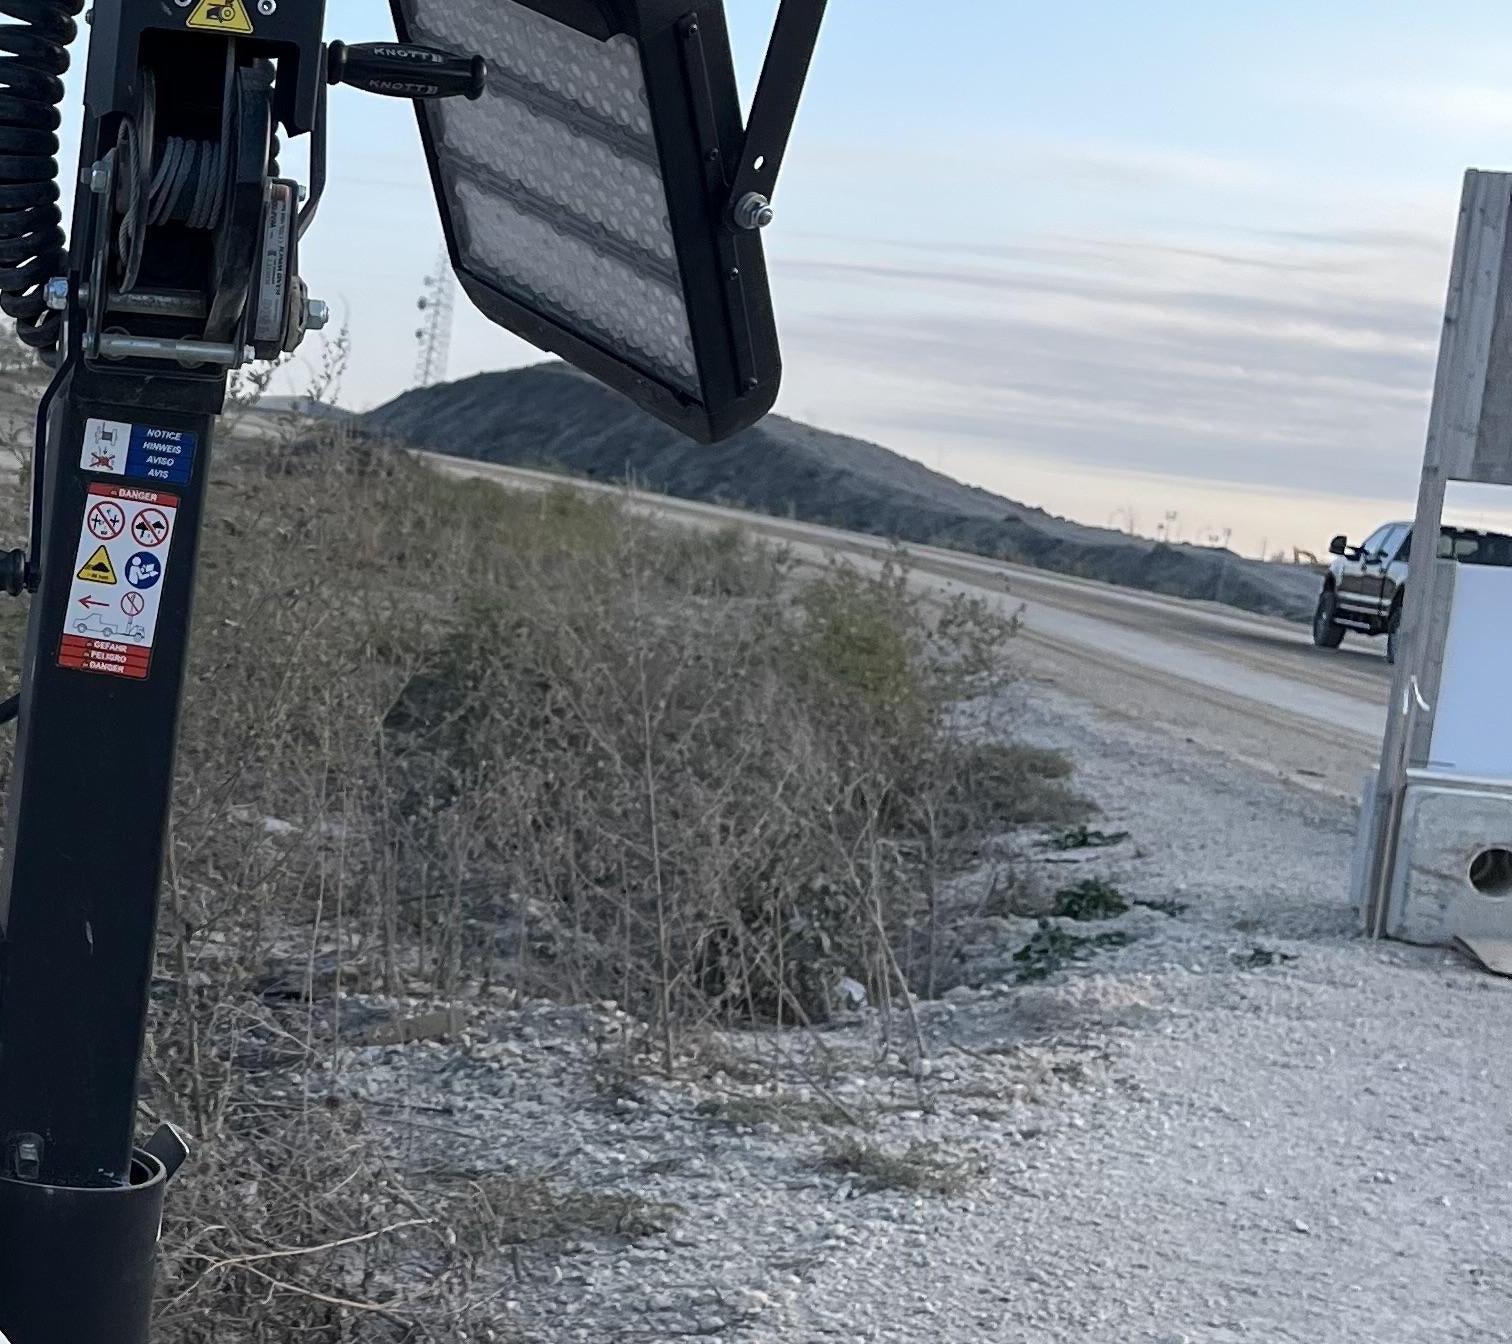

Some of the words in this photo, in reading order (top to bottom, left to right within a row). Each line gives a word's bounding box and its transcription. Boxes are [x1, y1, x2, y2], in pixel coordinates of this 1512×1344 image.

[374, 47, 430, 61] KNOTT
[369, 79, 426, 93] KNOTT
[147, 428, 183, 441] NOTICE
[143, 441, 182, 454] HINWEIS
[146, 455, 174, 467] AVISO
[148, 468, 169, 479] AVIS
[119, 488, 158, 502] DANGER
[93, 640, 127, 653] GEFAHR
[90, 650, 127, 664] PELIGRO
[89, 660, 125, 674] DANGER
